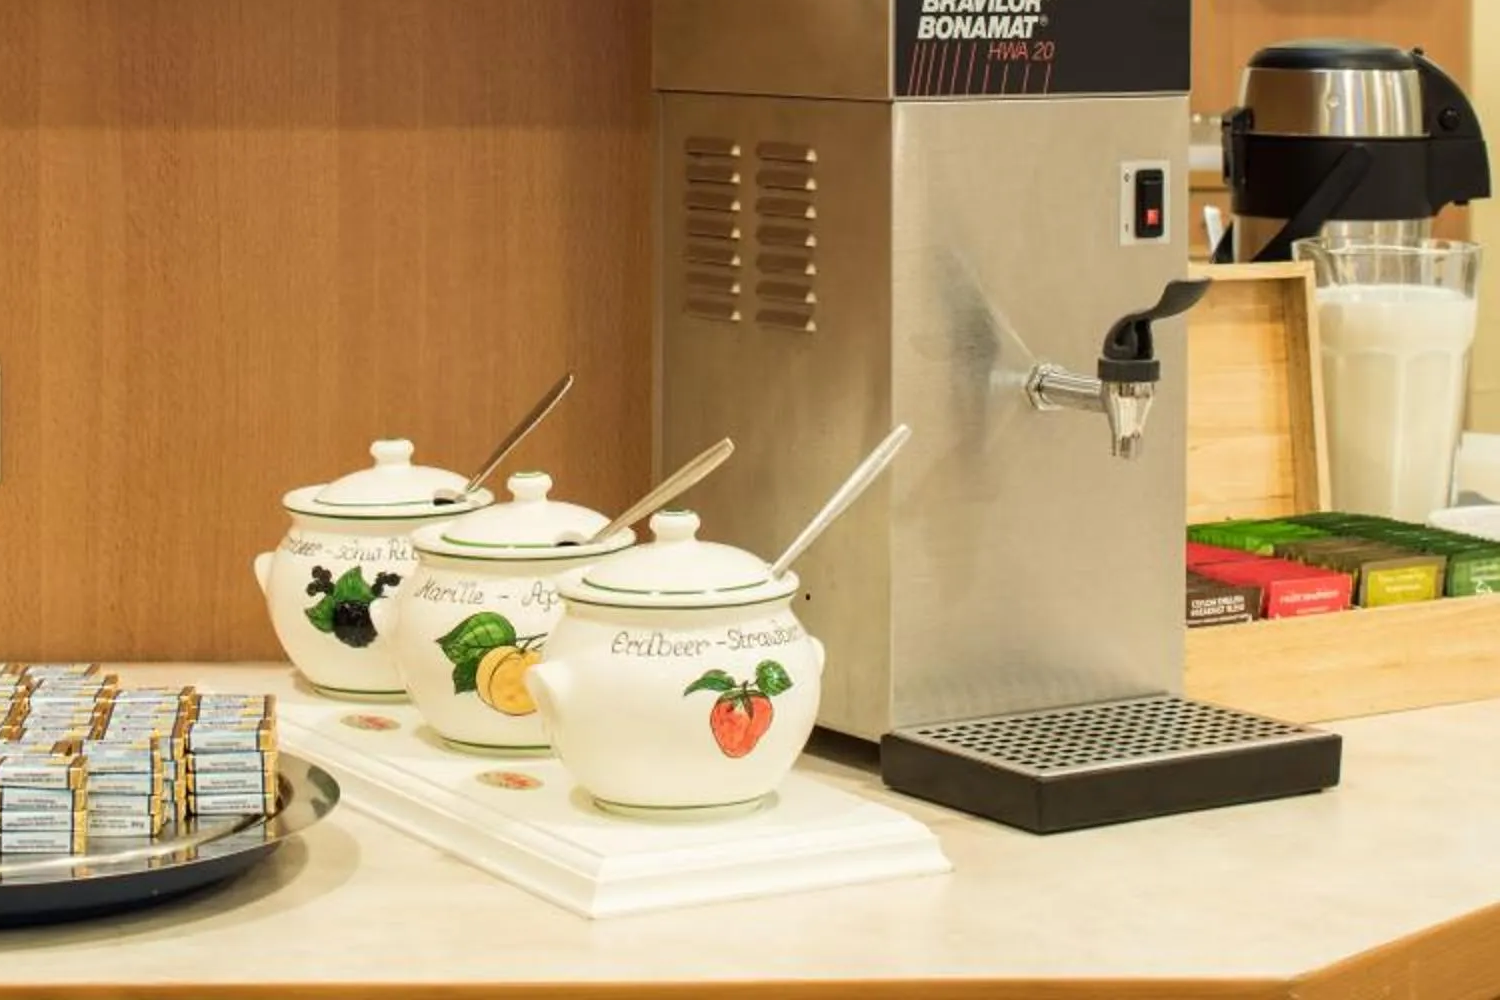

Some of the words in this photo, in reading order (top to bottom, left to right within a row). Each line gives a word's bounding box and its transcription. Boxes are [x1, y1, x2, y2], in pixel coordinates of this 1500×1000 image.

[917, 15, 1039, 40] BONAMAT
[988, 41, 1029, 61] HWA
[1031, 41, 1055, 61] 20
[413, 576, 484, 605] Marille
